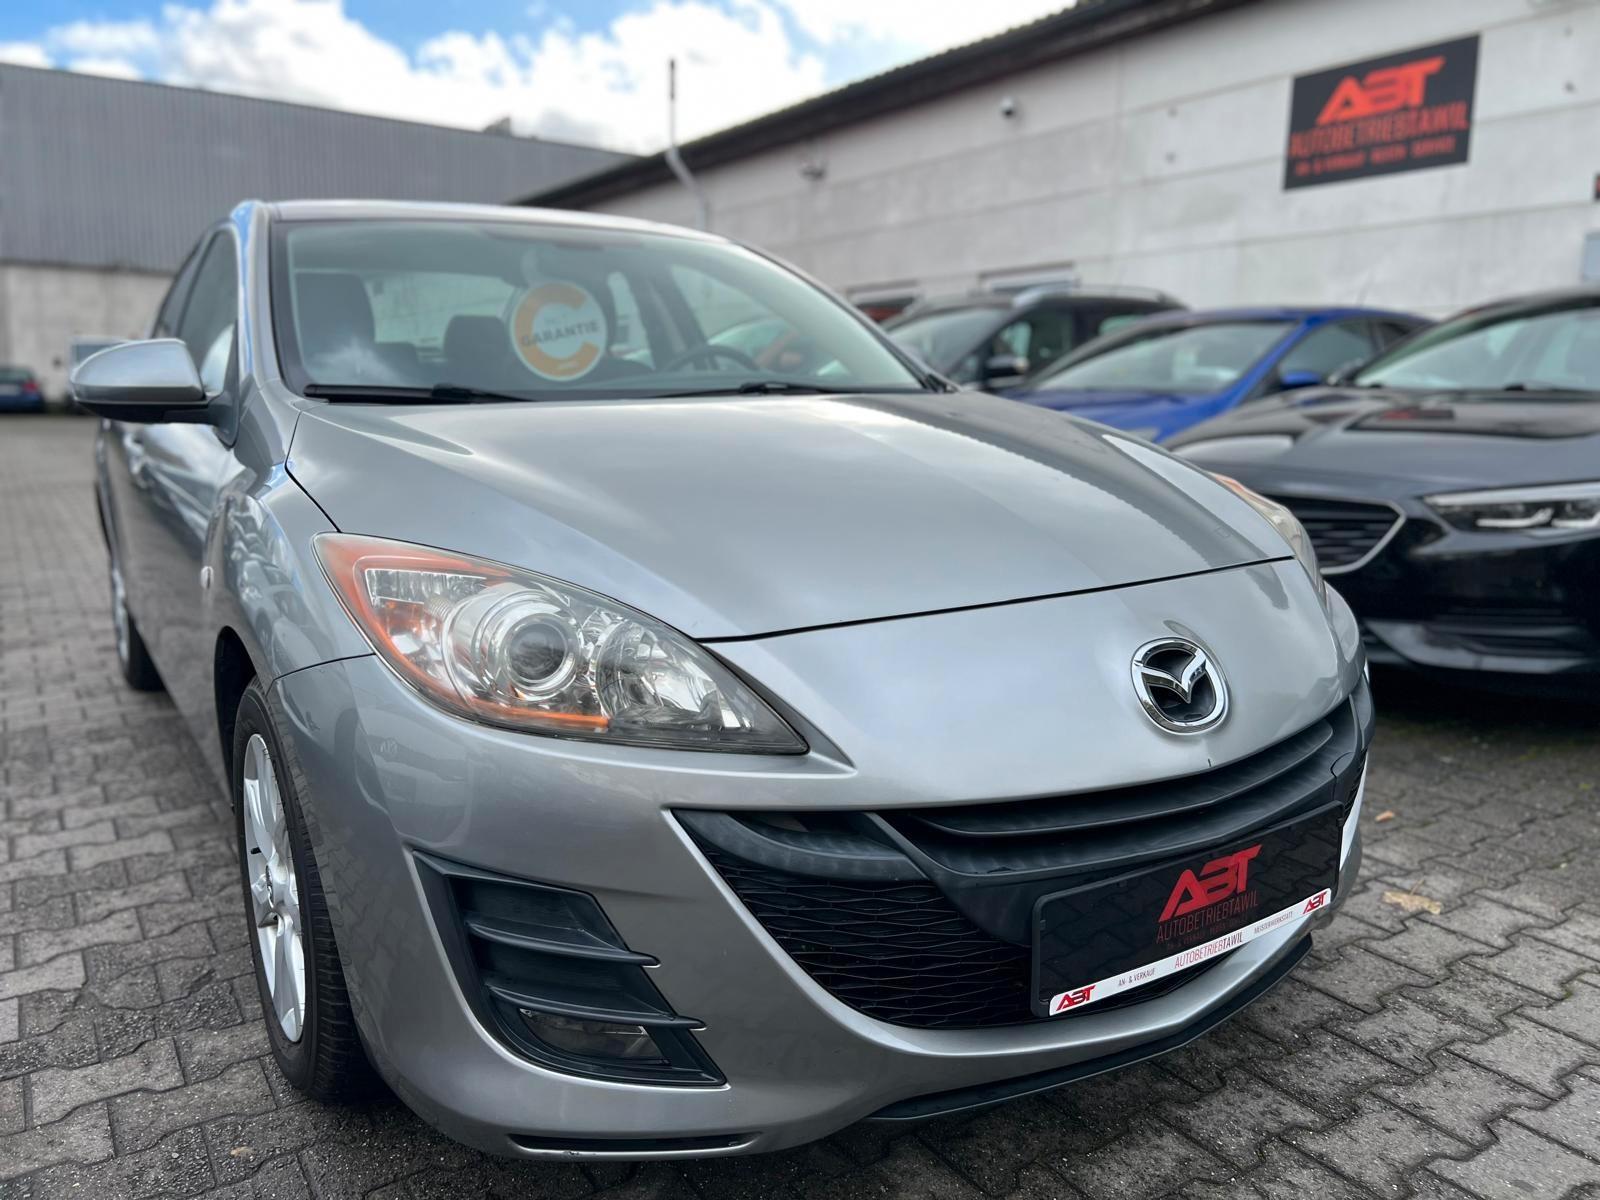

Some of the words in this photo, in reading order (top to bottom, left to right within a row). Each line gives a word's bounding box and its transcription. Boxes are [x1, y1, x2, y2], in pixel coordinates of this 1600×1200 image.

[1316, 55, 1447, 126] ABT
[521, 321, 599, 346] GARANTIE
[1156, 890, 1258, 944] AUTOBETRIEBTAWIL
[1158, 844, 1262, 923] ABT
[1056, 984, 1096, 1011] ABT
[1174, 931, 1244, 969] AUTOBETRIEBTAWIL
[1303, 891, 1328, 915] ABT
